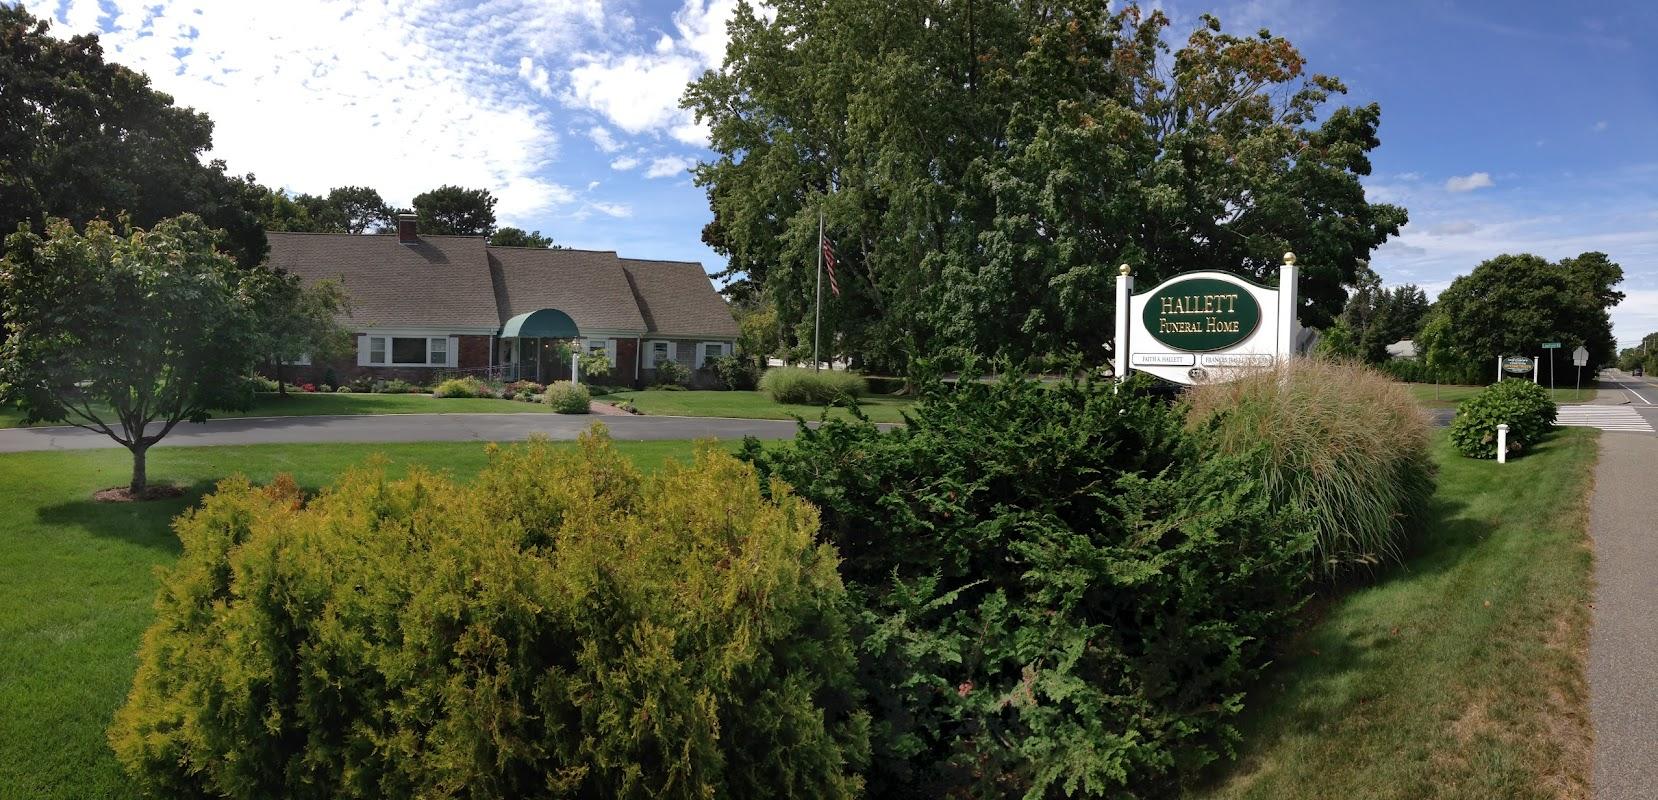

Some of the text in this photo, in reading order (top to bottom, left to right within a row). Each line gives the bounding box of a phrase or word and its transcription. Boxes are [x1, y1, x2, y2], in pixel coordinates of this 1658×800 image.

[1161, 294, 1238, 314] HALLETT
[1159, 316, 1240, 333] FUNERAL HOME
